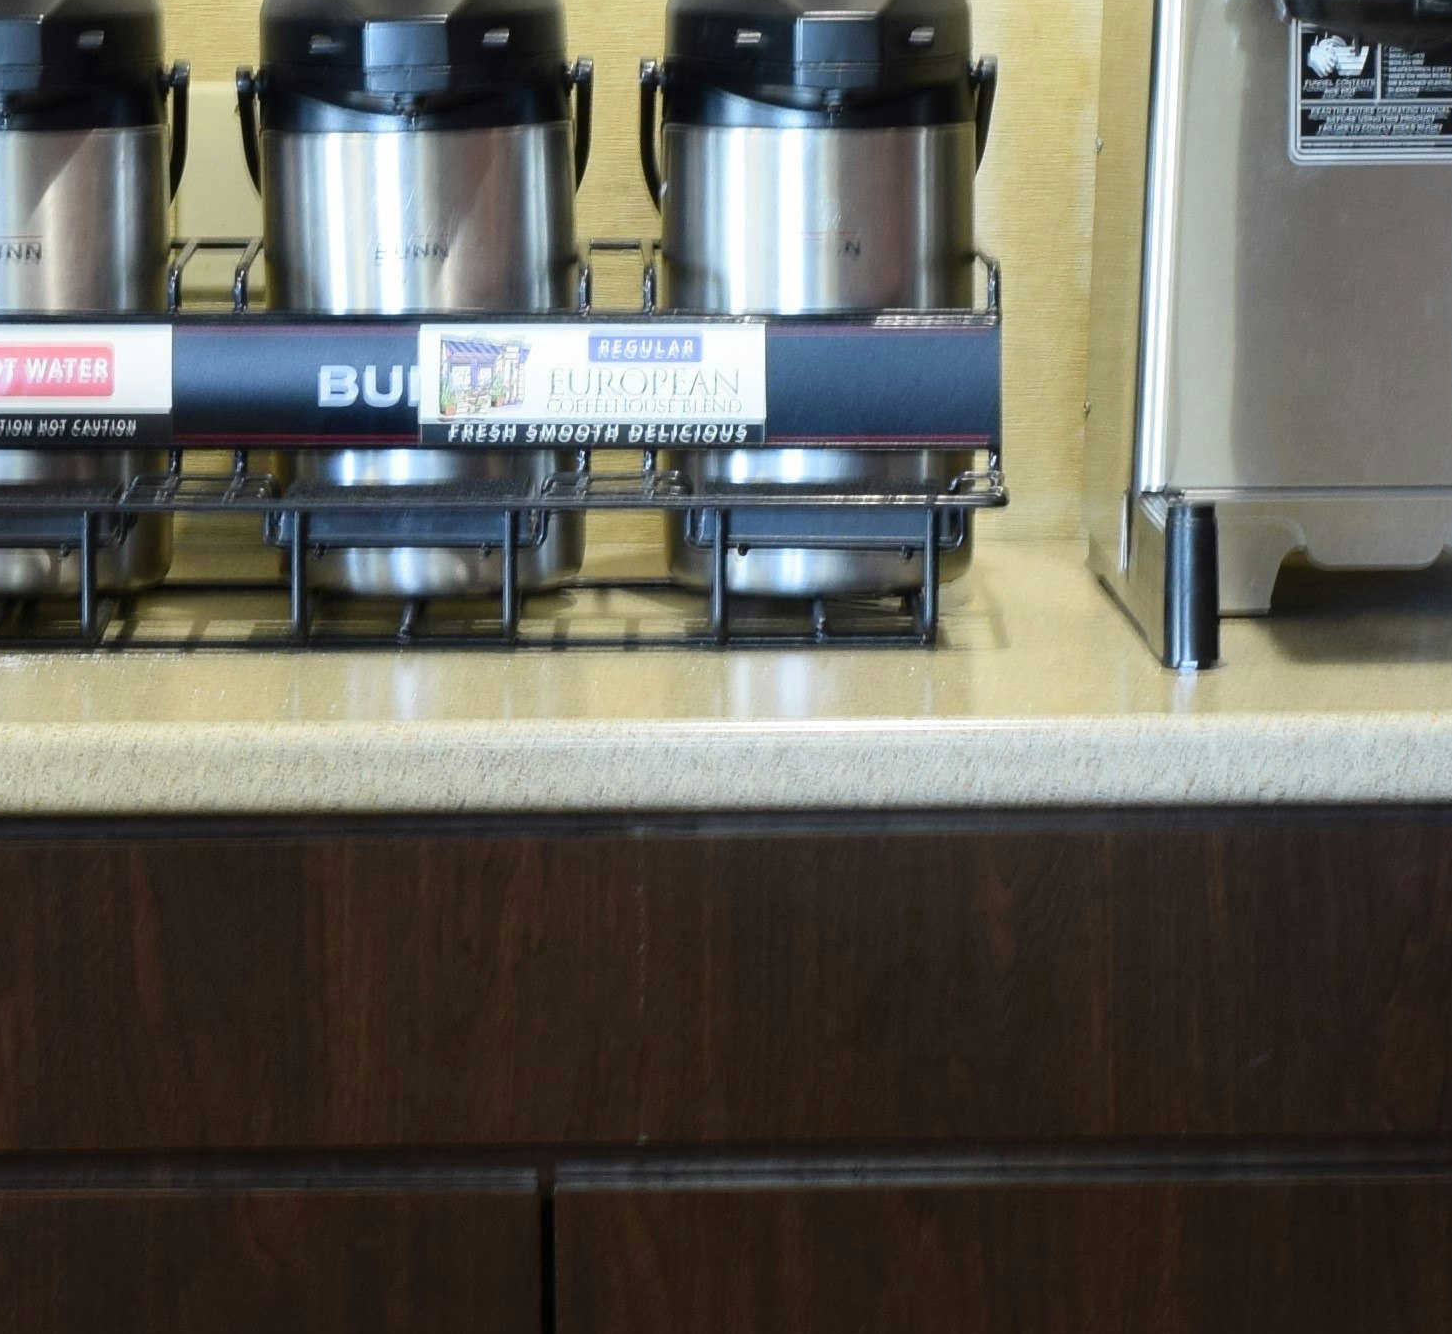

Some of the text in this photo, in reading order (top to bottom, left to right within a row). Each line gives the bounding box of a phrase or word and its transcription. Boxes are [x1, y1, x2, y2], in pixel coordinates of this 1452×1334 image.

[598, 339, 695, 359] REGULAR
[25, 357, 109, 384] WATER
[317, 363, 421, 407] BU
[549, 367, 740, 396] EUROPEAN
[547, 398, 743, 414] COFFEEHOUSE BLEND
[37, 419, 68, 437] HOT
[71, 419, 137, 437] CAUTION
[448, 424, 747, 443] FRESH SMOOTH DELICIOUS
